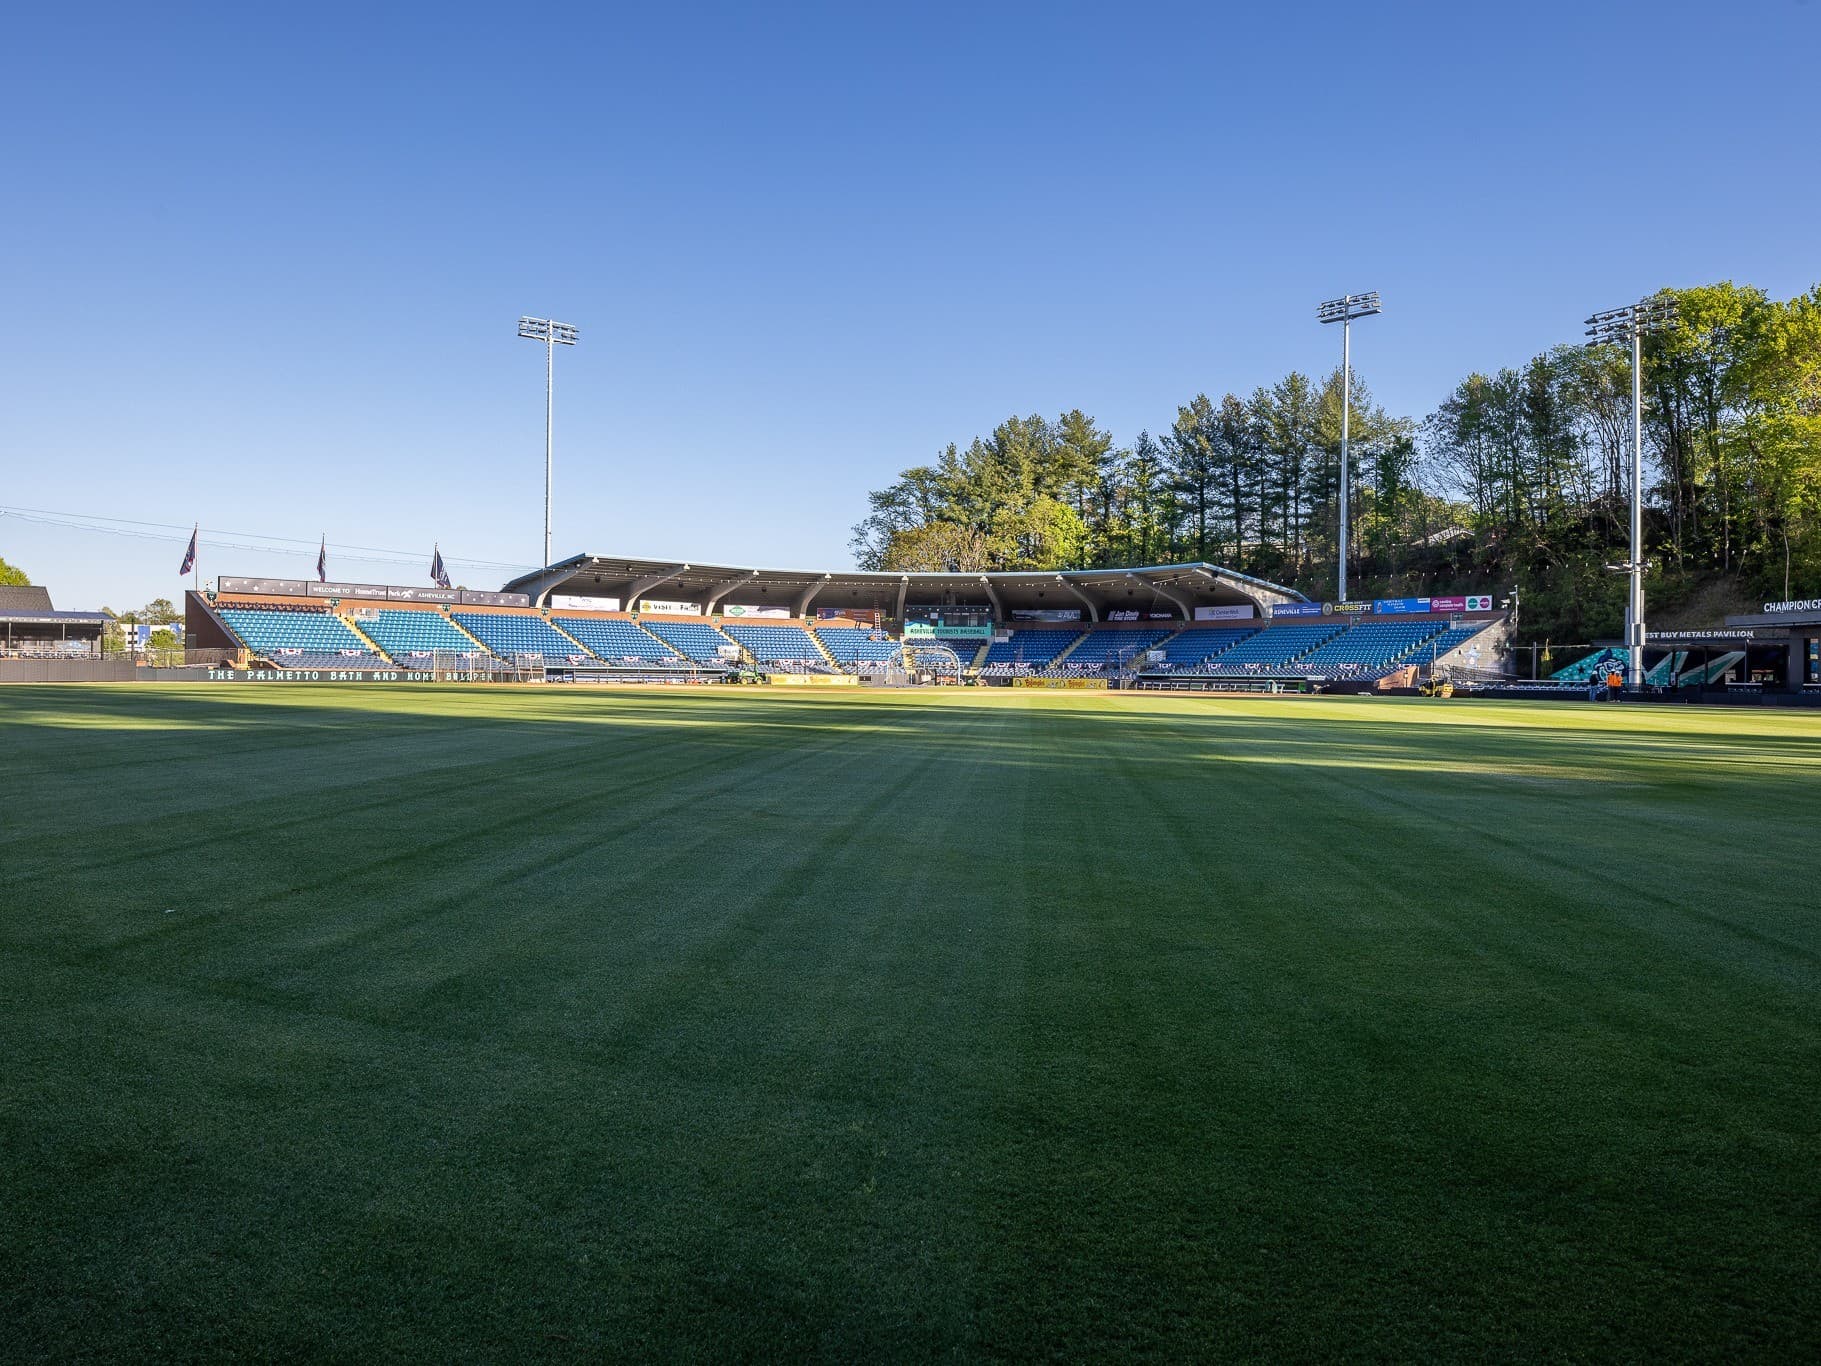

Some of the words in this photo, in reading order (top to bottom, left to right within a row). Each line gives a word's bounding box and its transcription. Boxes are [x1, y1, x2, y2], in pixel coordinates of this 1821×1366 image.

[313, 586, 341, 595] WELCOME
[1334, 604, 1372, 612] CROSSFIT
[1764, 600, 1810, 612] CHAMPION
[1660, 631, 1677, 639] BUY
[1713, 630, 1754, 639] PAVILION
[208, 670, 235, 680] THE
[247, 670, 319, 680] PALMETTO
[330, 671, 363, 680] BATH
[373, 671, 397, 681] AND
